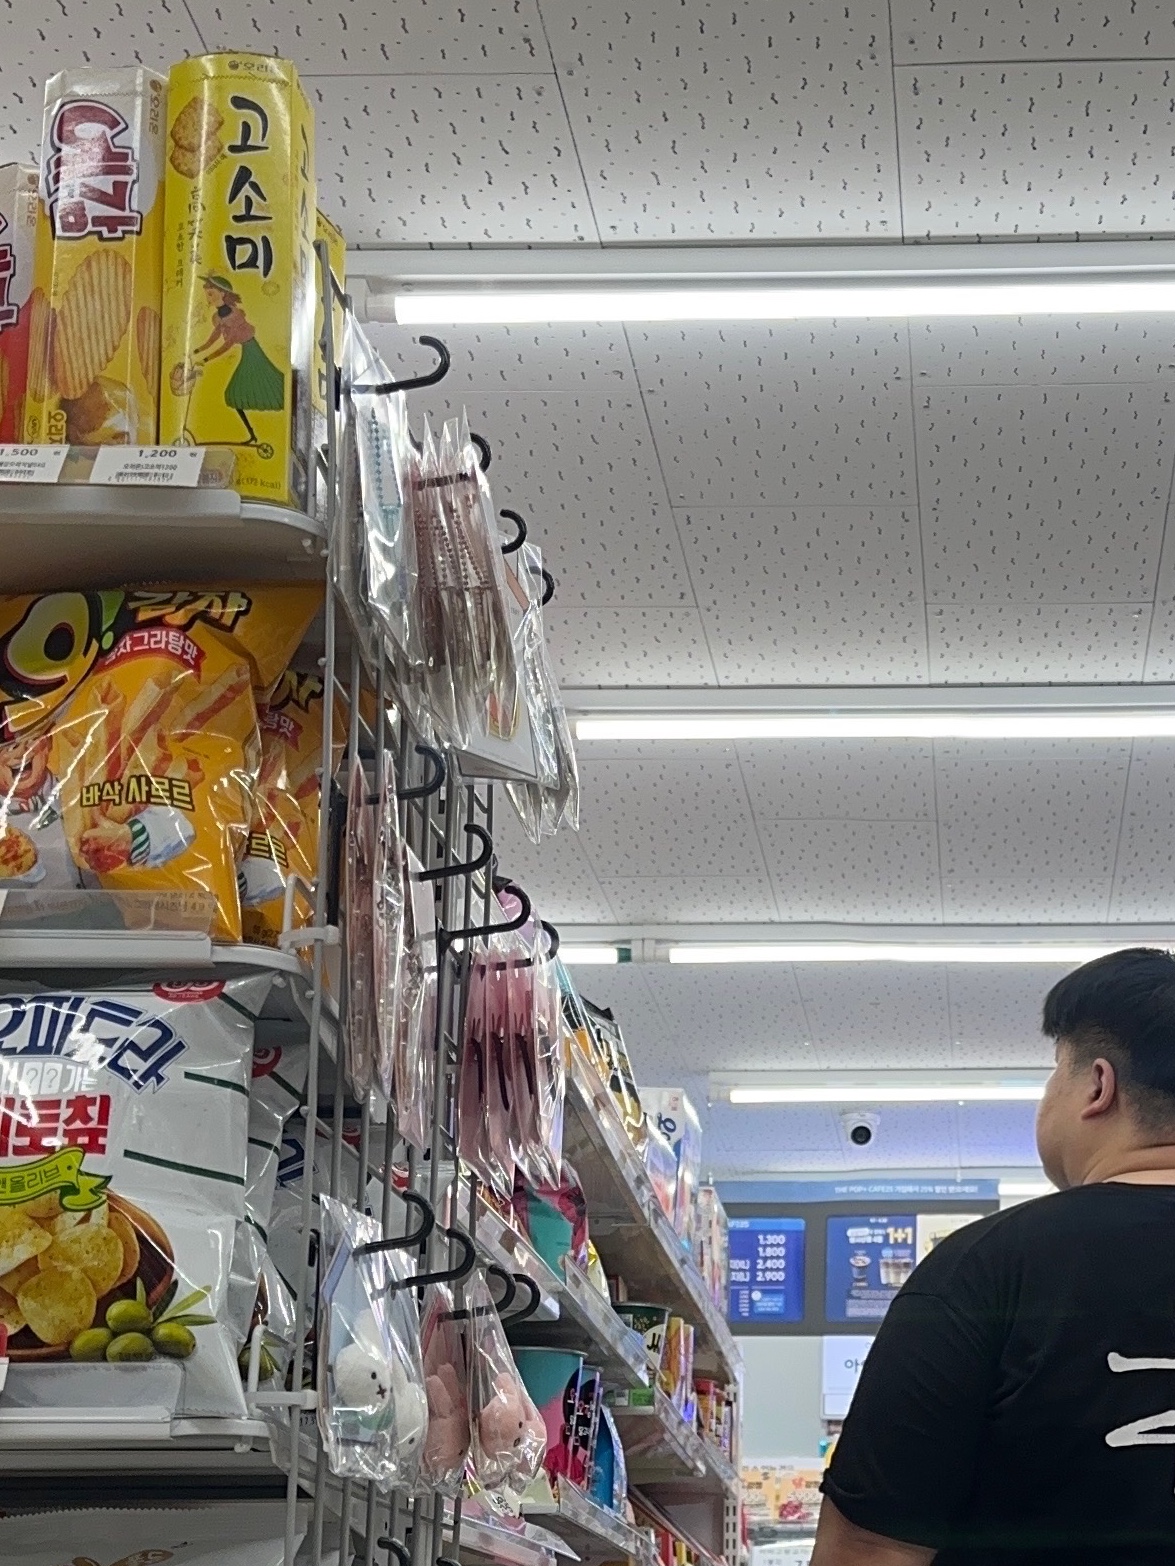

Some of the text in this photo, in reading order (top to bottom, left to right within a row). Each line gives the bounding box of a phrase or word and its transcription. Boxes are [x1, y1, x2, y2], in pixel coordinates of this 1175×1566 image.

[226, 94, 275, 279] 고소미
[138, 449, 177, 459] 1,200
[81, 775, 195, 812] 바삭 사르르
[886, 1227, 913, 1244] 1+1
